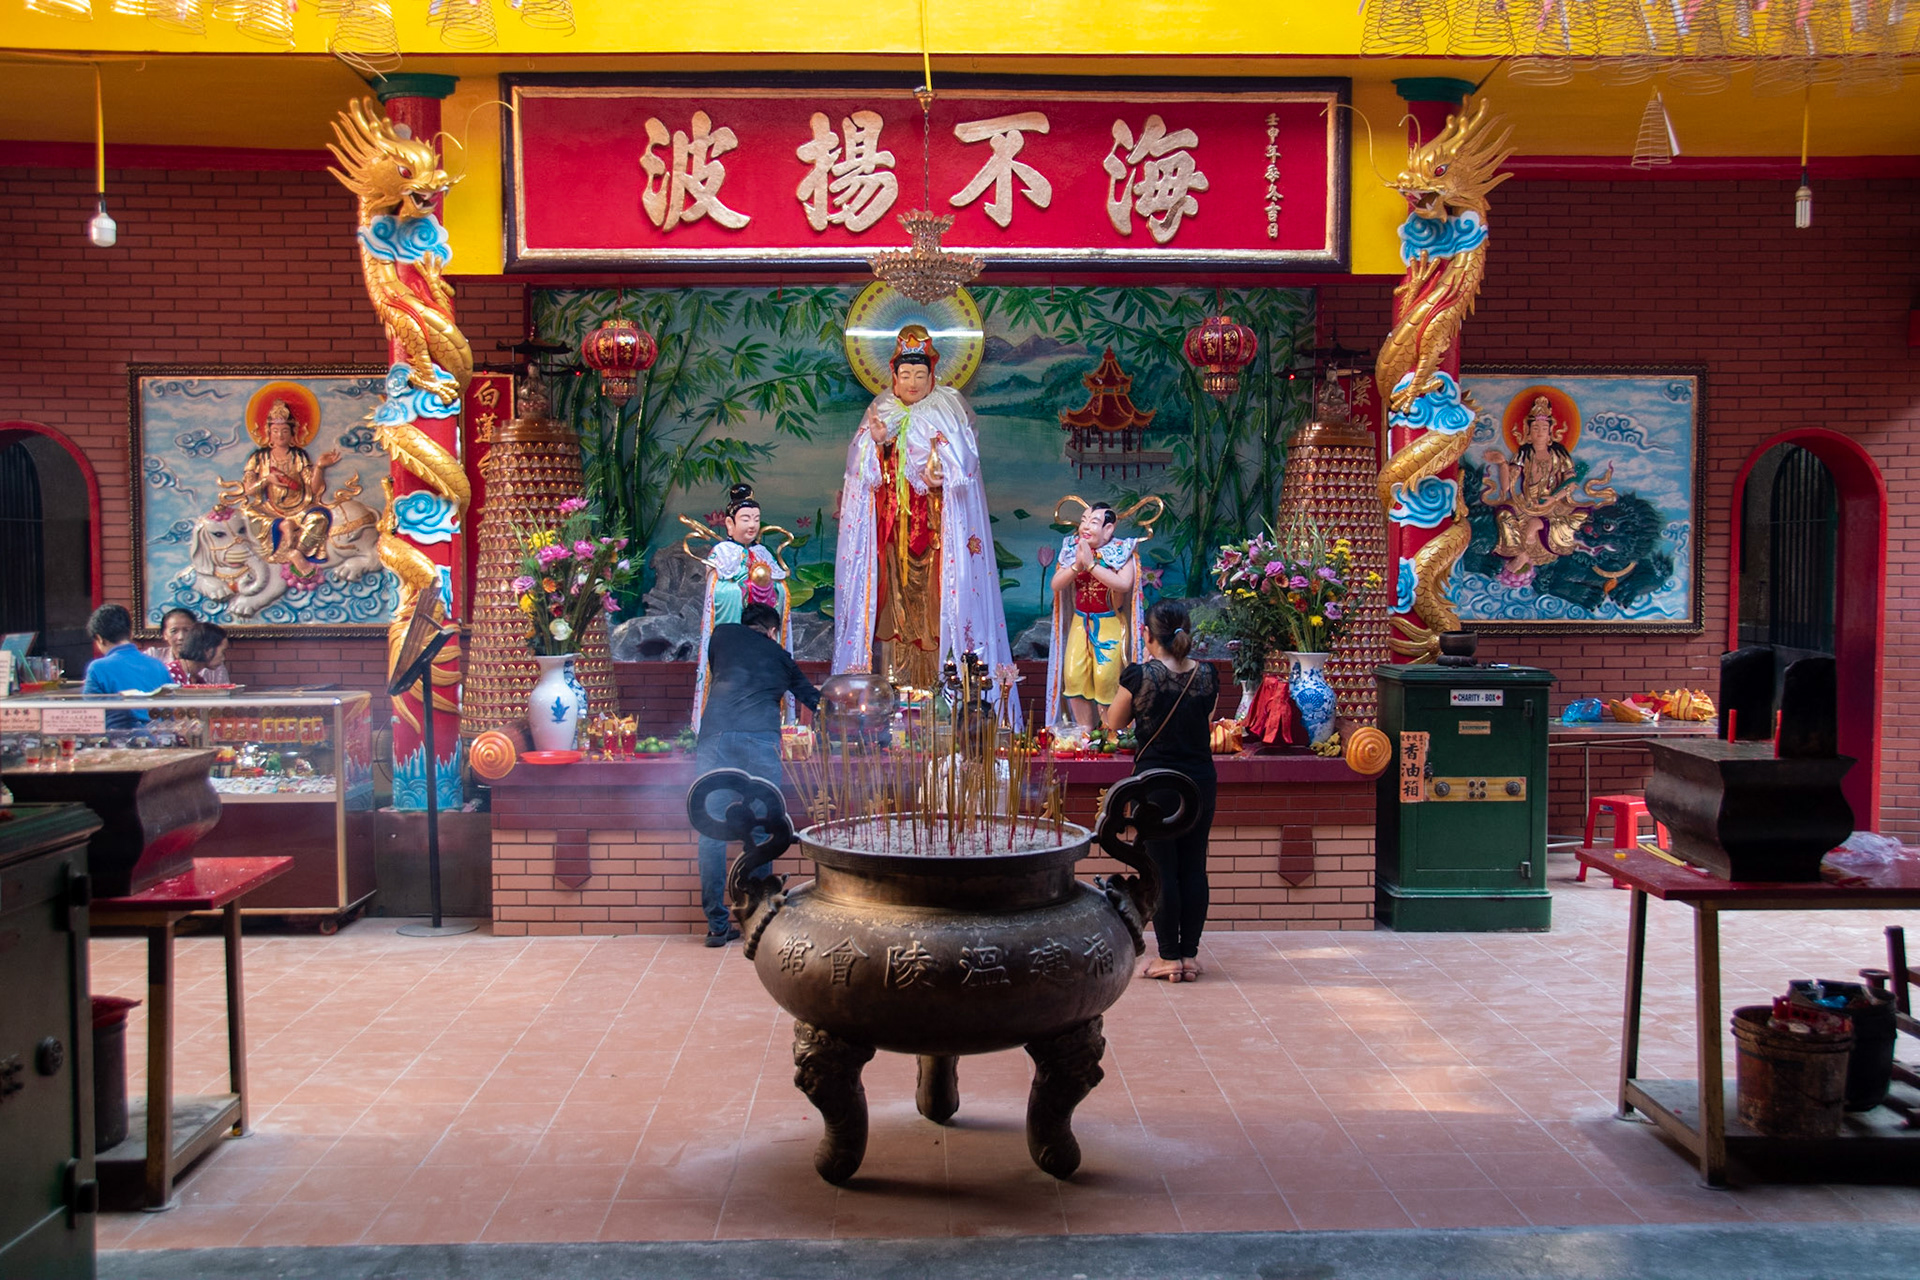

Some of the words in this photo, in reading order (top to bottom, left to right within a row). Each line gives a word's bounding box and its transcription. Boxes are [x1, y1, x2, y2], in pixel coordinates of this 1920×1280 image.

[639, 110, 1209, 245] 海不揚波
[1458, 693, 1480, 702] CHARITY
[1484, 693, 1496, 702] BOX
[1401, 743, 1420, 797] 香油箱
